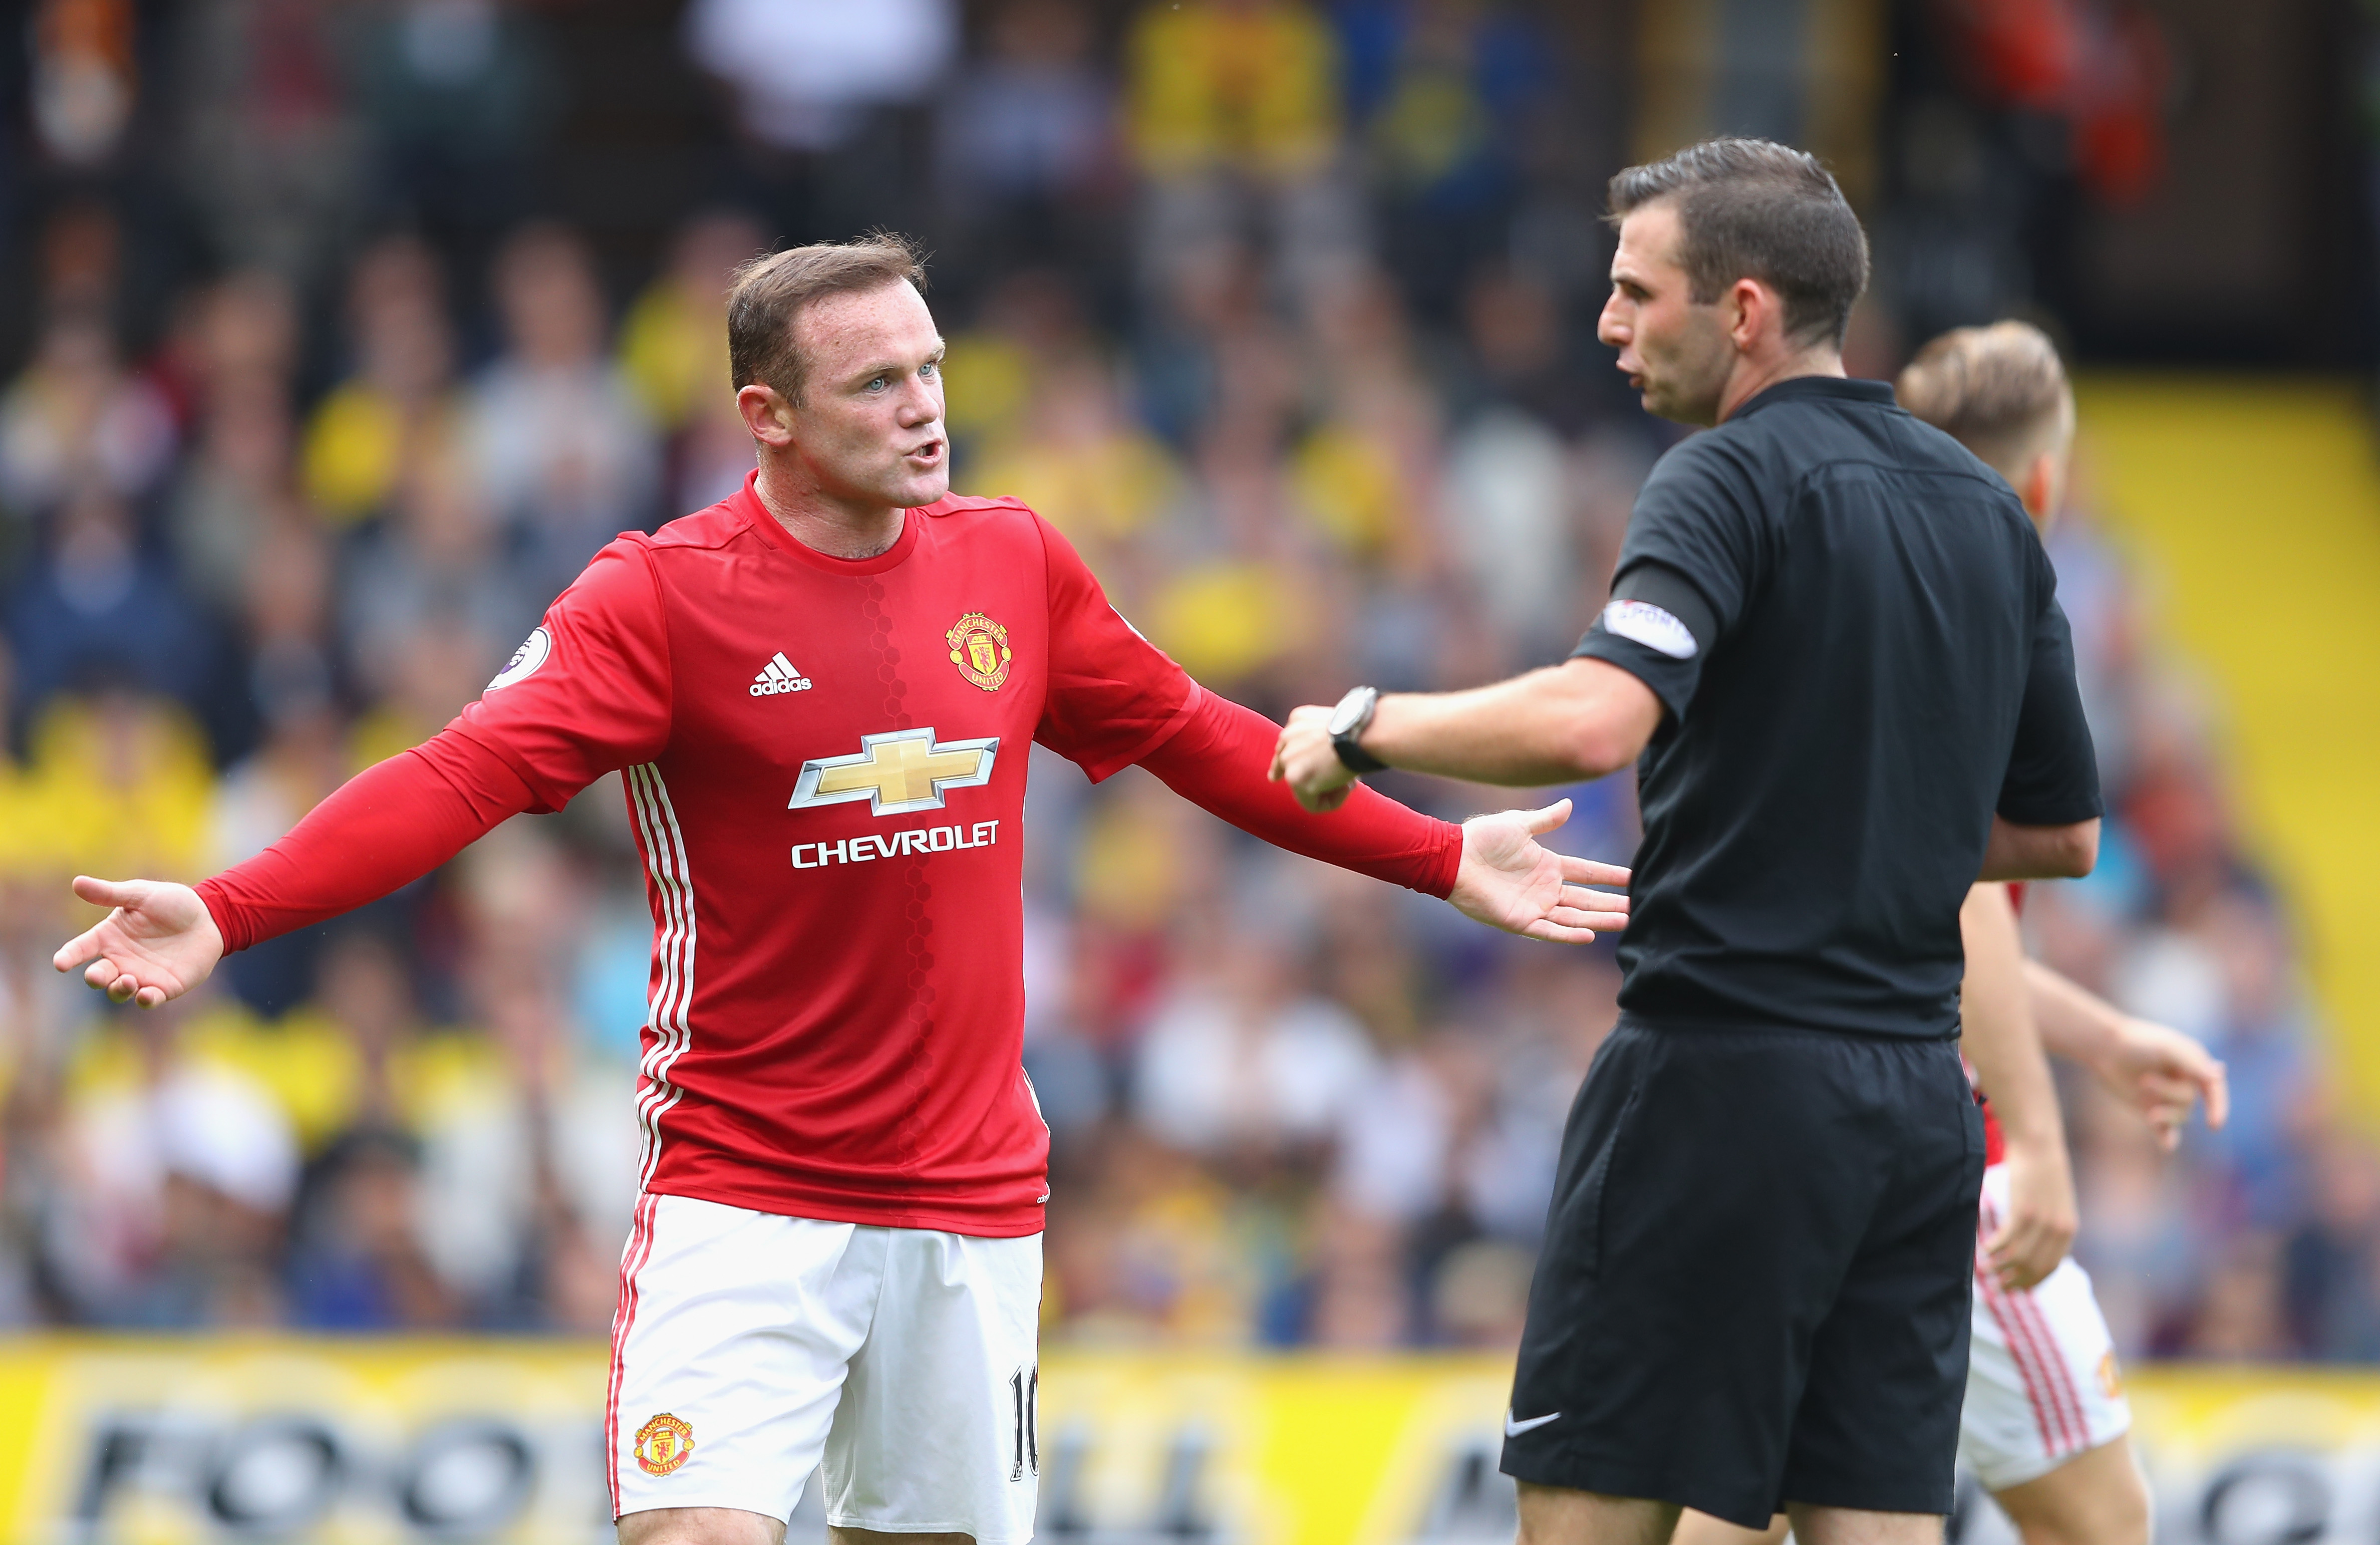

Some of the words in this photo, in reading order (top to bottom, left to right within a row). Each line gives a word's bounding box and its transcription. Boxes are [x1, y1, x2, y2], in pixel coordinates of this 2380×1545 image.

[953, 618, 1004, 644] MANCHESTER
[749, 677, 812, 696] adidas
[972, 672, 1004, 685] UNITED
[791, 820, 1000, 869] CHEVROLET
[639, 1418, 688, 1441] MANCHESTER
[646, 1459, 680, 1472] UNITED
